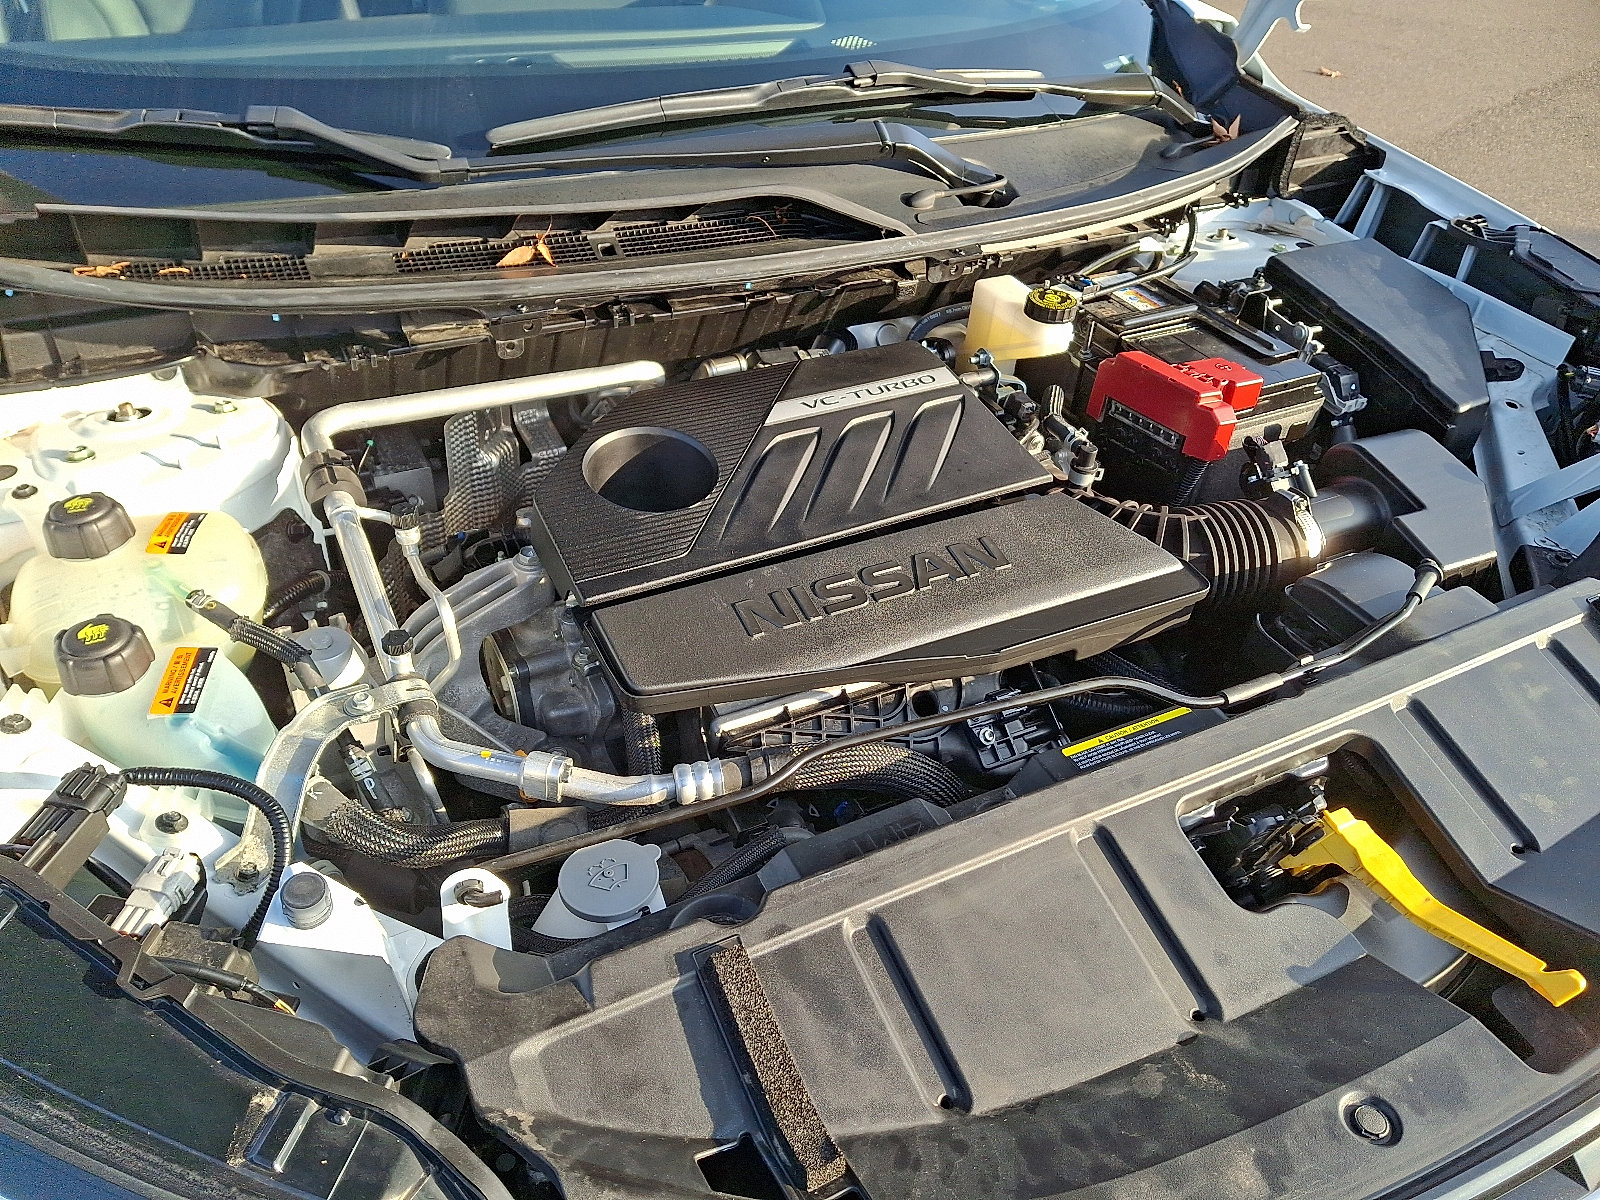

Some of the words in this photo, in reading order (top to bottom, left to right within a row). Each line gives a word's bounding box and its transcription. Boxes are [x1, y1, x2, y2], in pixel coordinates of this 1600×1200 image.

[799, 373, 937, 410] VC-TURBO
[730, 535, 1012, 639] NISSAN
[171, 652, 192, 694] AVERTISSEMENT
[1104, 729, 1129, 741] CAUTION
[1132, 718, 1160, 732] ATTENTION
